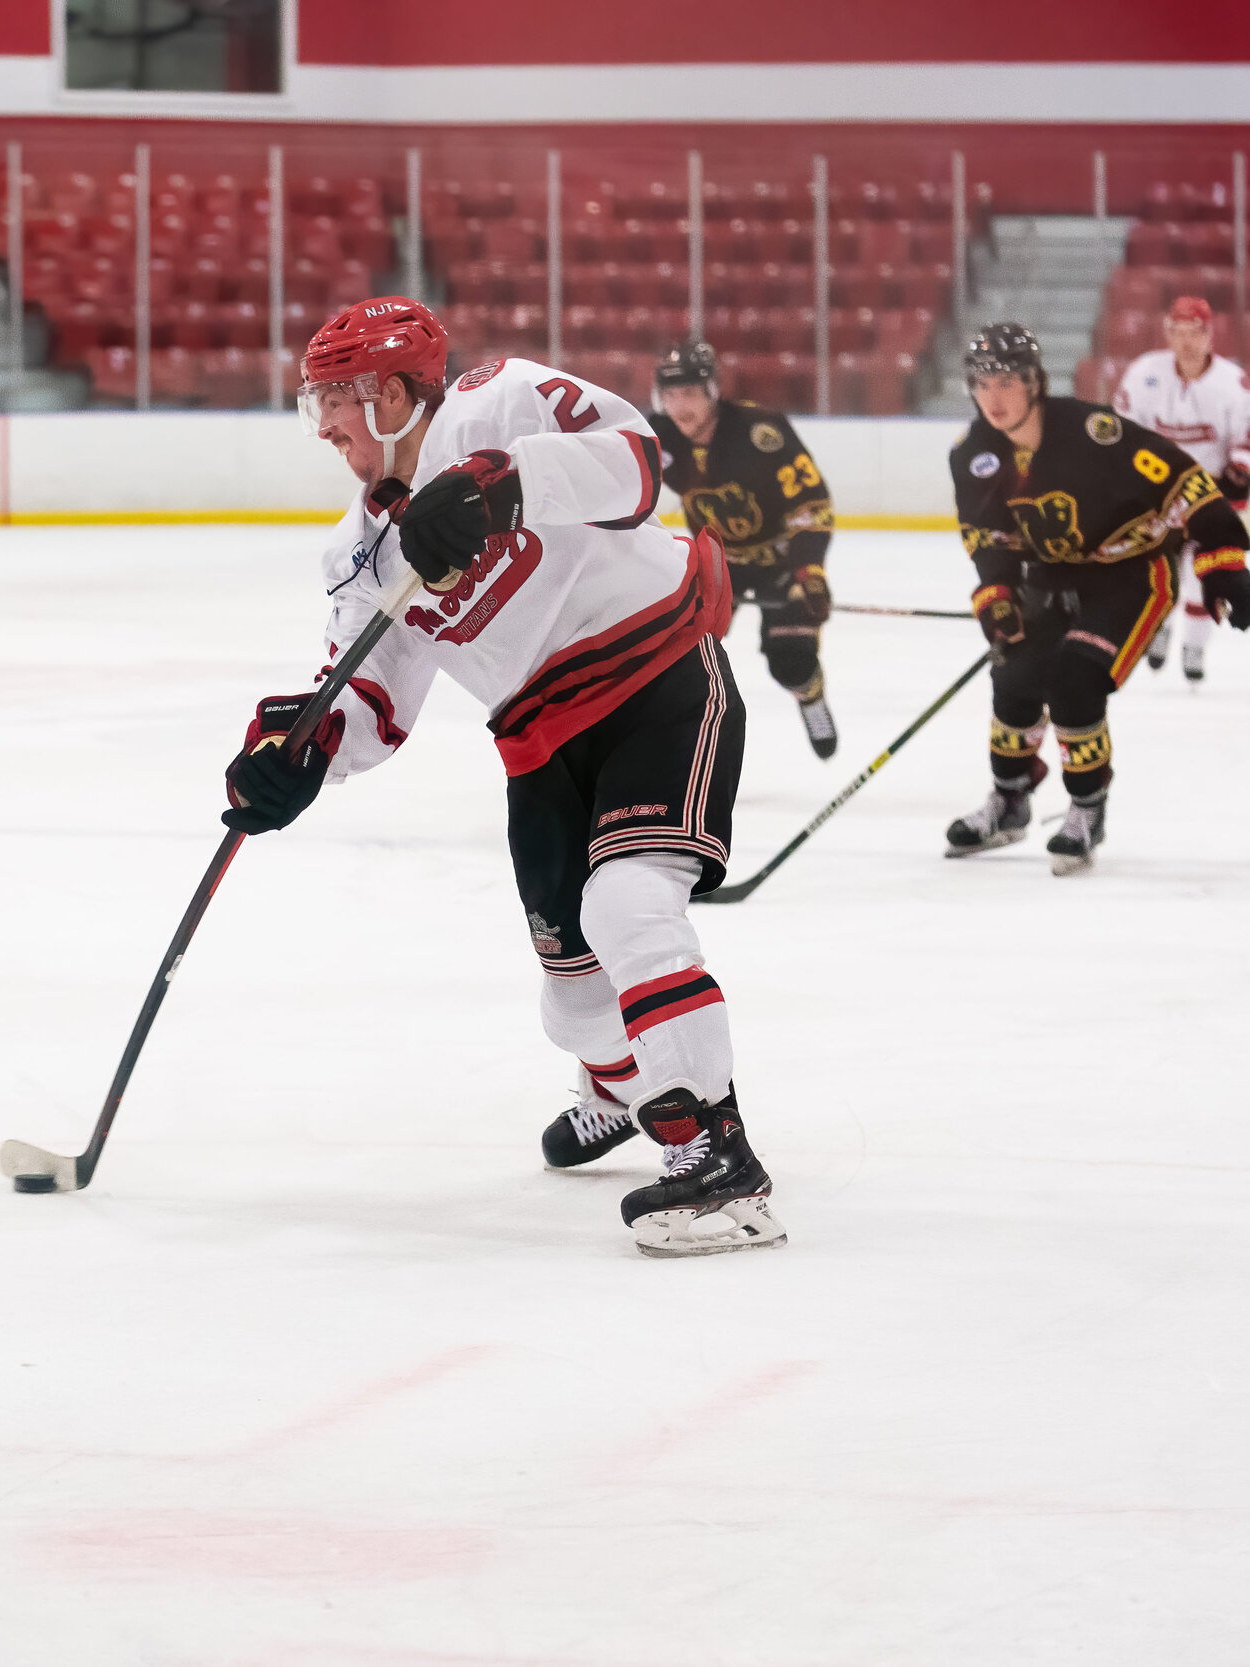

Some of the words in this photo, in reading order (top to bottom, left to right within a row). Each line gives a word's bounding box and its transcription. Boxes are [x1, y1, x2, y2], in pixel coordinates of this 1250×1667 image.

[364, 302, 393, 319] NJT
[534, 377, 601, 433] 2
[776, 453, 821, 499] 23
[1132, 448, 1171, 485] 8
[264, 703, 300, 713] BAUER
[596, 803, 669, 829] BAUER
